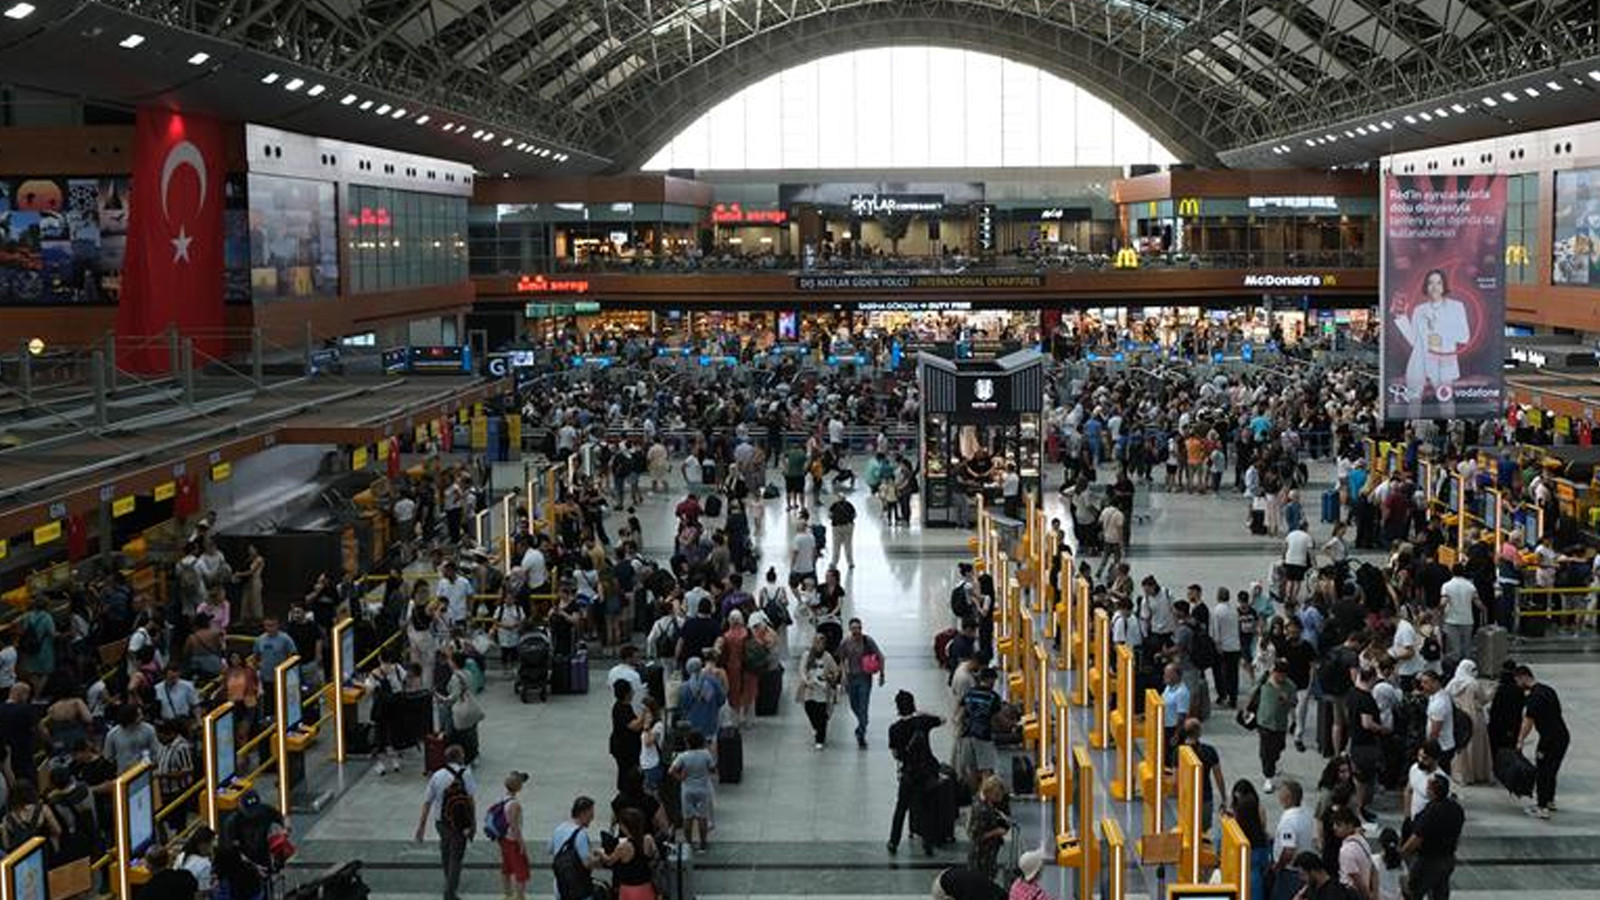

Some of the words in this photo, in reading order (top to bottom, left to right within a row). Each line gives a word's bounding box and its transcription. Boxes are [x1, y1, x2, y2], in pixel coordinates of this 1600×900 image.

[852, 193, 896, 215] SKYLAR
[817, 279, 850, 287] HATLAR
[882, 278, 910, 287] YOLCU
[917, 277, 985, 286] INTERNATIONAL
[986, 277, 1041, 286] DEPARTURES
[1244, 275, 1321, 287] McDonald's
[490, 358, 505, 376] G
[1455, 388, 1500, 397] vodafone
